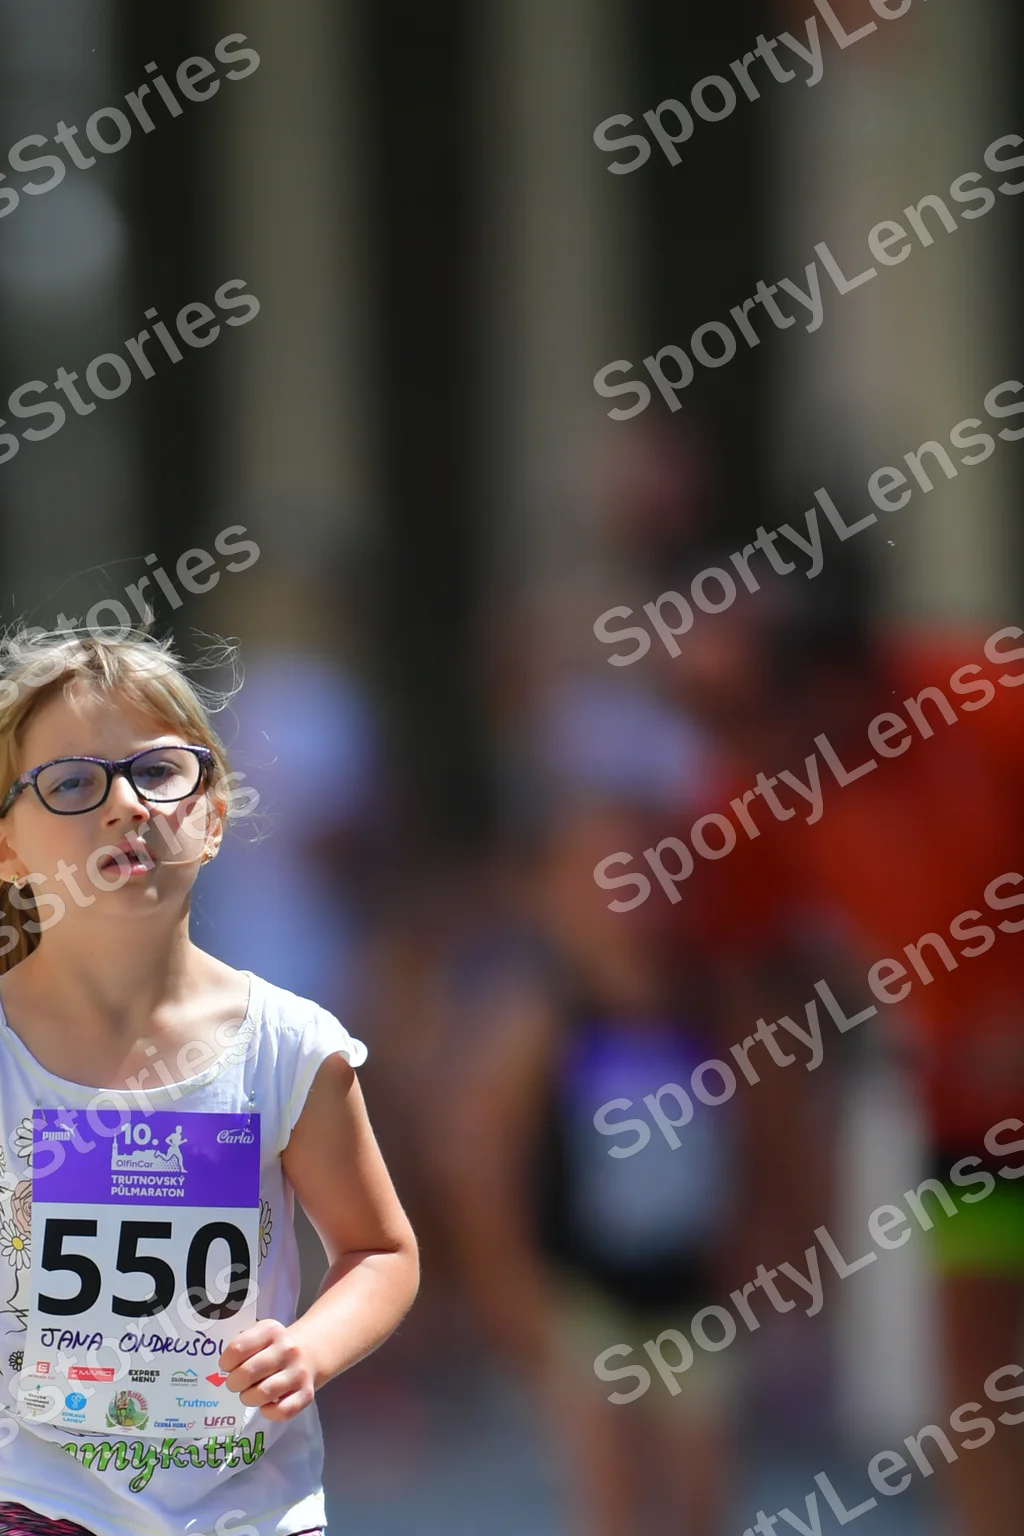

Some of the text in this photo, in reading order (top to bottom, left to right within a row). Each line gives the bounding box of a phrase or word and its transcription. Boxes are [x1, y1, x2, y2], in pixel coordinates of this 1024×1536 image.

[42, 1130, 72, 1141] PUMA
[121, 1123, 159, 1145] 10.
[216, 1128, 254, 1145] Carla
[116, 1159, 153, 1169] OlfinCar
[111, 1174, 185, 1187] TRUTNOVSKÝ
[111, 1185, 185, 1198] PŮLMARATON
[37, 1218, 251, 1320] 550
[41, 1328, 104, 1351] JANA
[128, 1369, 160, 1377] EXPRES
[131, 1376, 156, 1384] MENU
[175, 1397, 219, 1409] Trutnov
